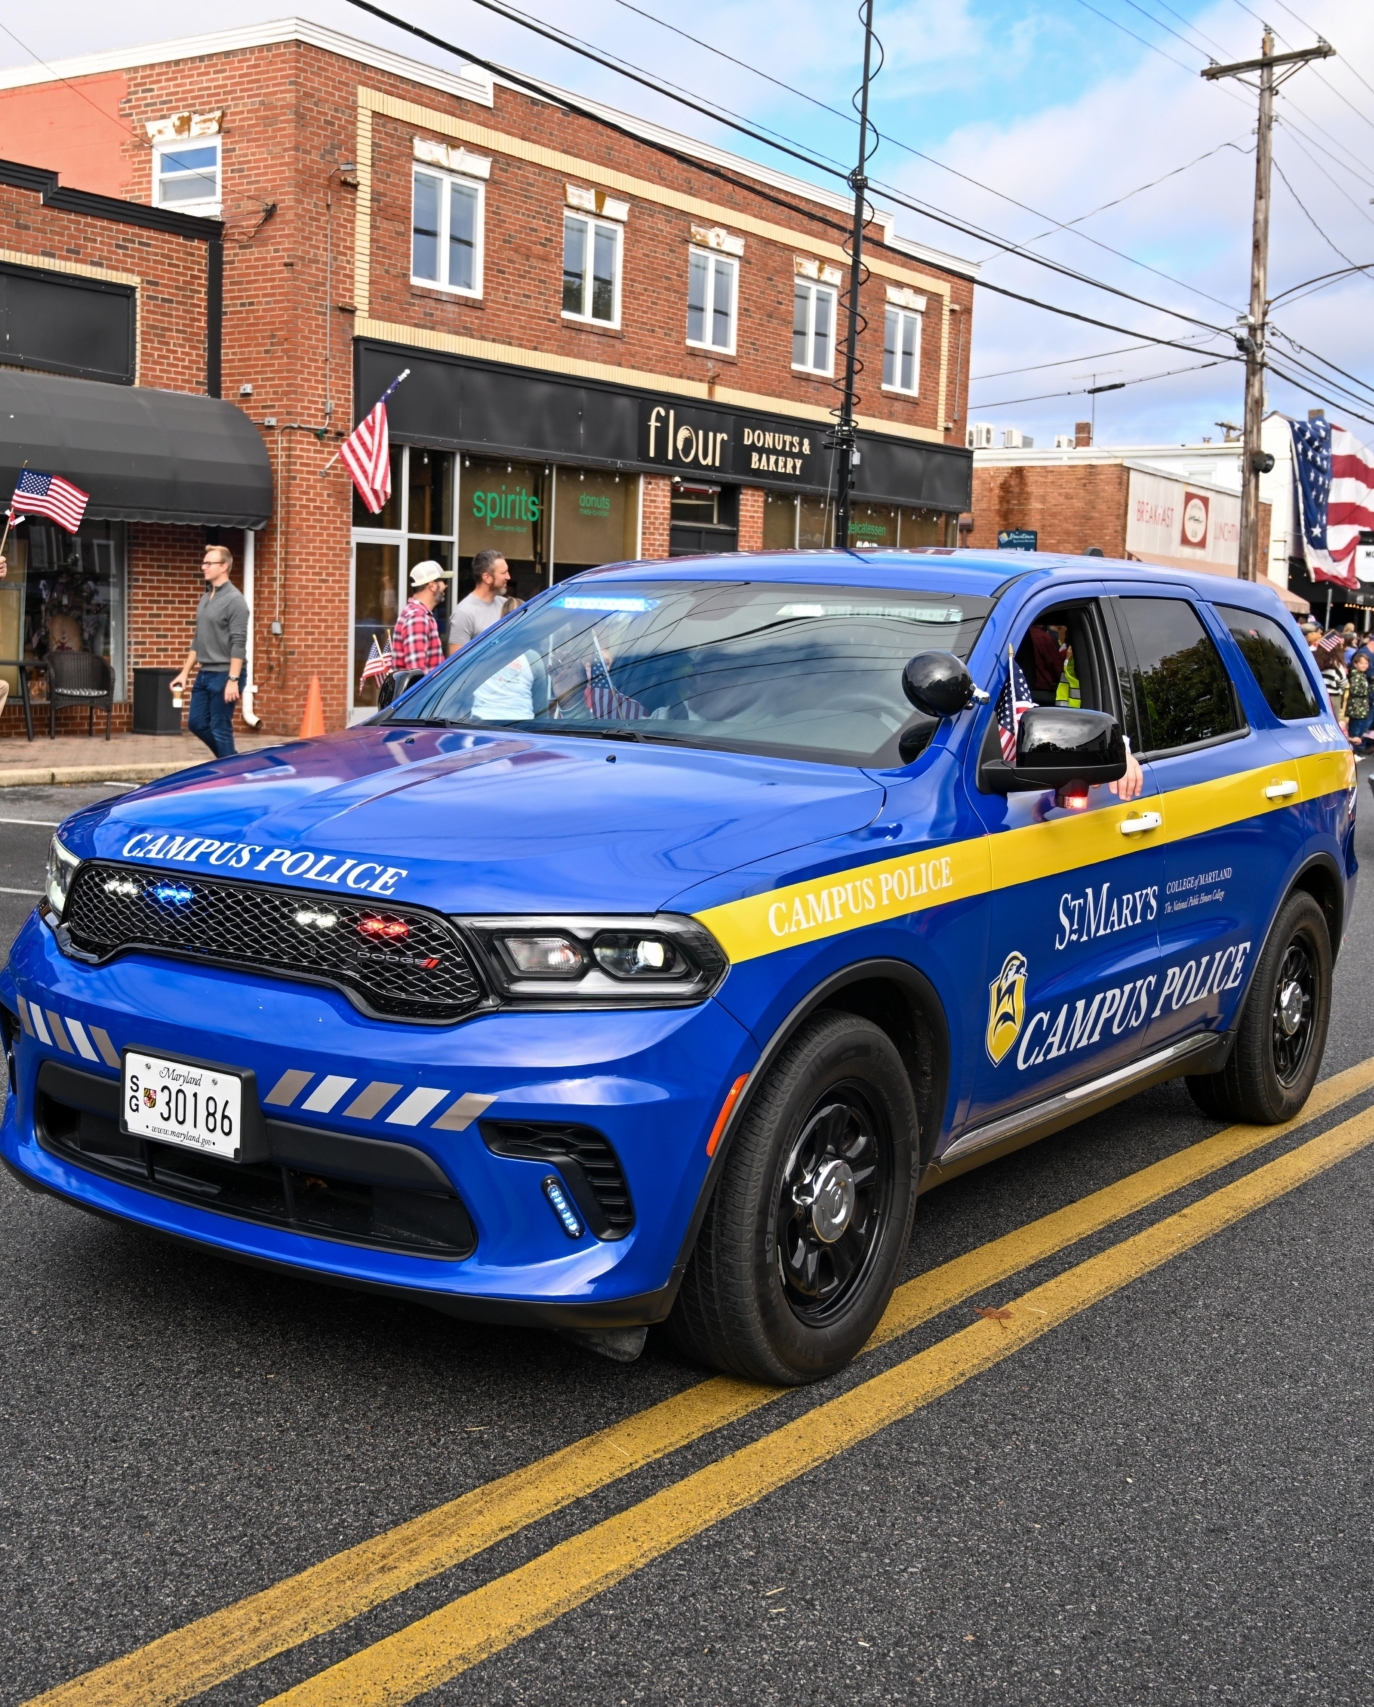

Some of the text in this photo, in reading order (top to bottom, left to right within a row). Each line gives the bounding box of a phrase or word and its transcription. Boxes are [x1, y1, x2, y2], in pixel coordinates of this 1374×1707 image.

[647, 406, 728, 467] flour
[743, 428, 811, 455] DONUTS &
[751, 452, 803, 475] BAKERY
[473, 485, 539, 526] spirits
[579, 492, 610, 509] donuts
[1136, 500, 1174, 528] BREAKFAST
[122, 833, 408, 896] CAMPUS POLICE
[1166, 876, 1195, 895] COLLEGE
[1199, 867, 1232, 886] MARYLAND
[768, 856, 953, 937] CAMPUS POLICE
[357, 951, 428, 968] DODGE
[1016, 941, 1251, 1071] CAMPUS POLICE
[159, 1066, 203, 1087] Maryland
[160, 1085, 233, 1137] 30186
[151, 1125, 212, 1147] www.maryland.gov
